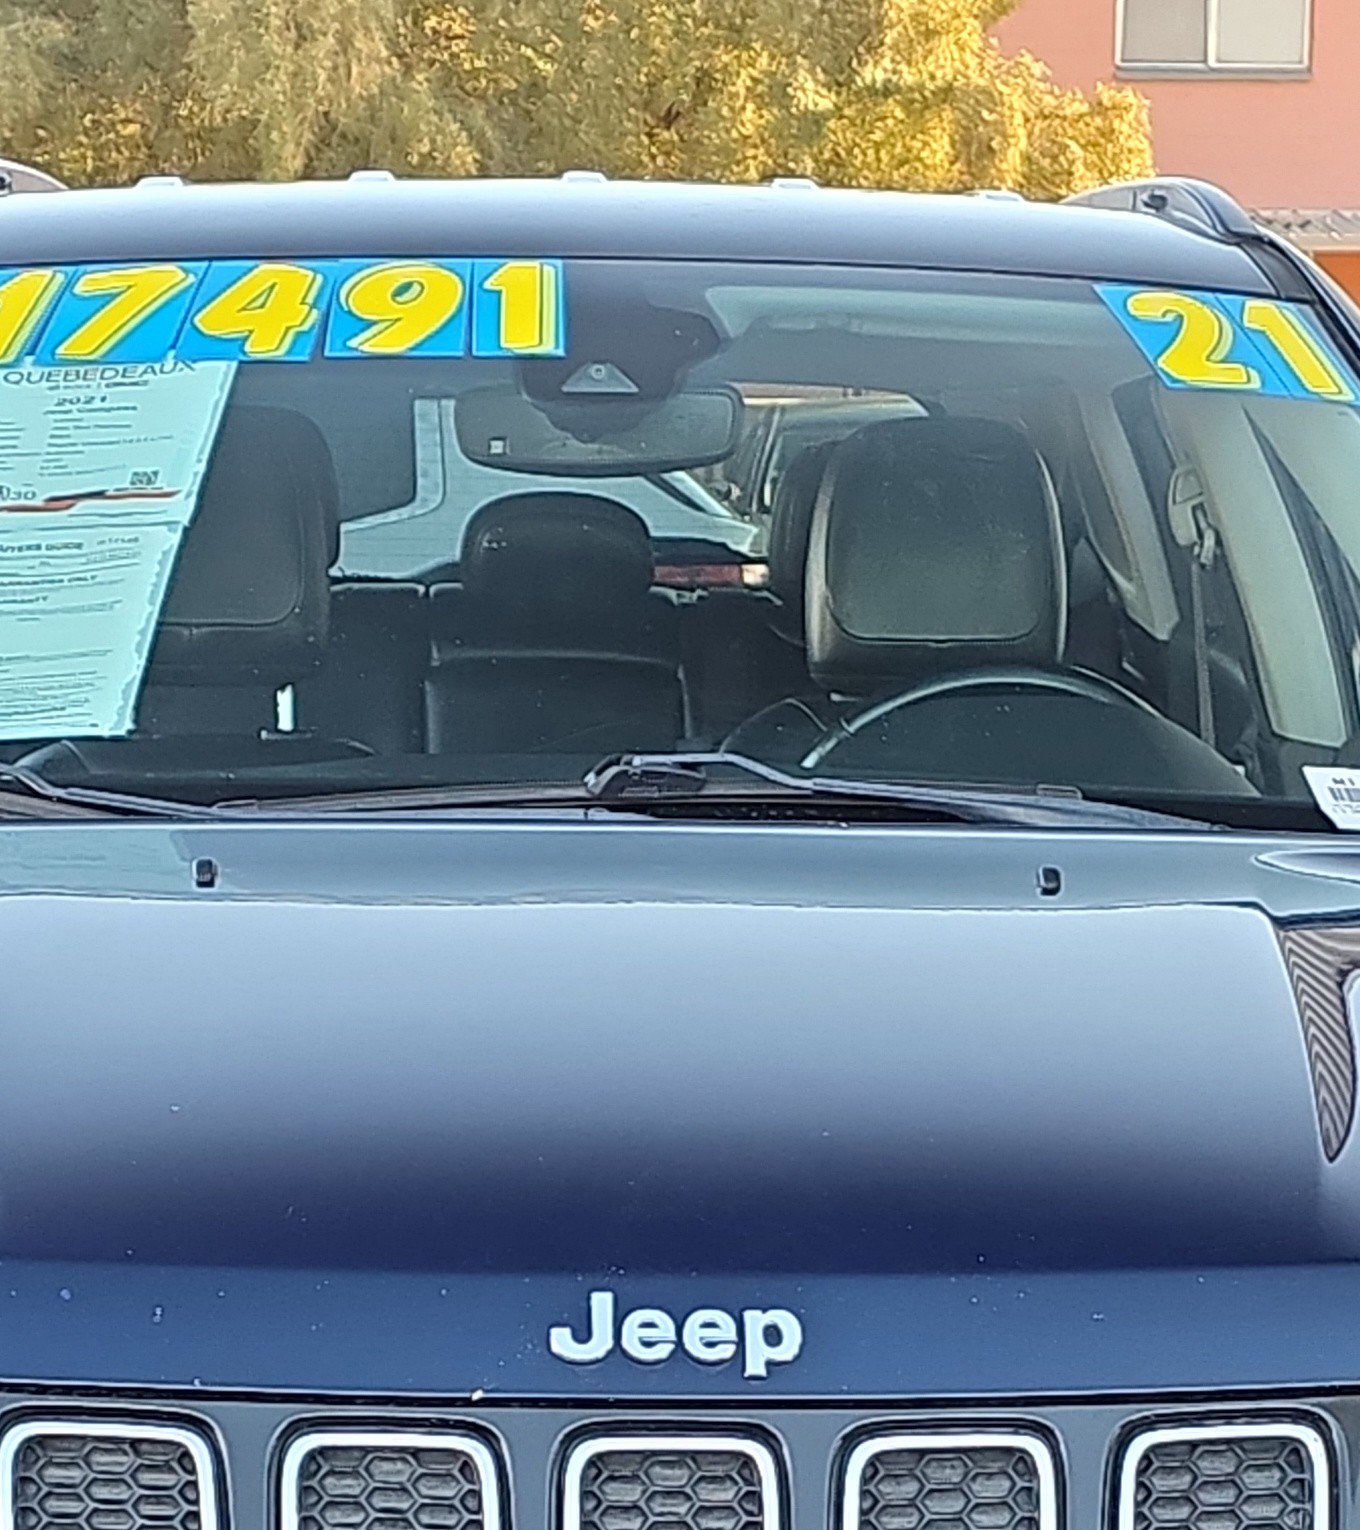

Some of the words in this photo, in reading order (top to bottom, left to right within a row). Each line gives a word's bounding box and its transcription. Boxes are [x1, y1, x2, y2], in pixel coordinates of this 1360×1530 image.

[2, 361, 196, 386] QUEBEDEAUX
[1126, 291, 1356, 401] 21
[549, 1290, 803, 1378] Jeep
